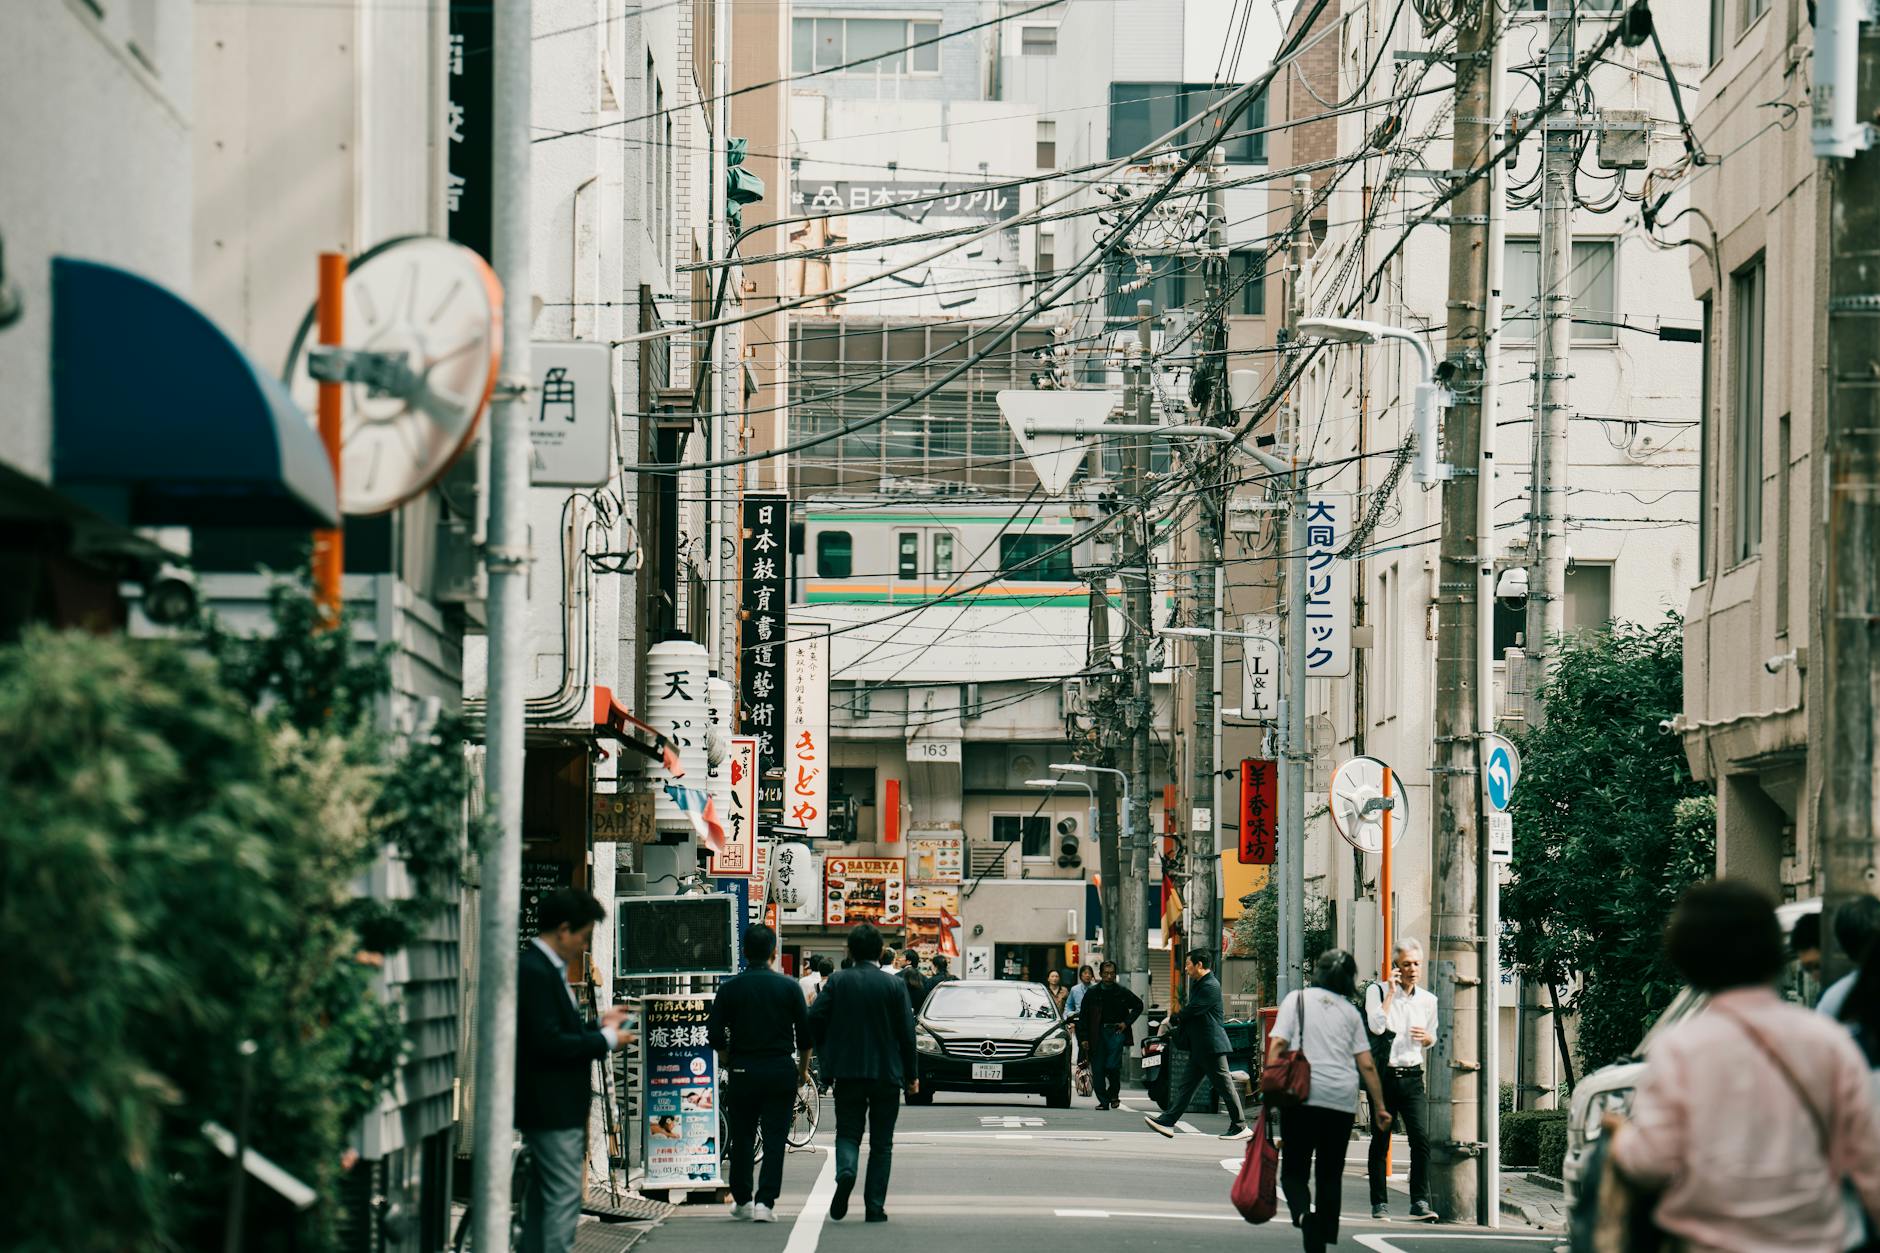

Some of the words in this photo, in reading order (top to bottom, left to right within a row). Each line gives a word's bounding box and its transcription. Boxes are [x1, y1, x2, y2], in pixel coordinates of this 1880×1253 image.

[849, 186, 1007, 211] 日本マテリアル
[1306, 501, 1335, 668] 大同クリニック
[751, 505, 778, 755] 日本教育書道藝術院
[922, 744, 947, 756] 163
[792, 730, 819, 828] きどや
[1246, 764, 1269, 860] 羊香味坊
[847, 861, 899, 870] SAURYA
[648, 1013, 710, 1022] リラクゼーション
[654, 1000, 705, 1011] 台湾式本格
[649, 1025, 710, 1048] 癒楽縁
